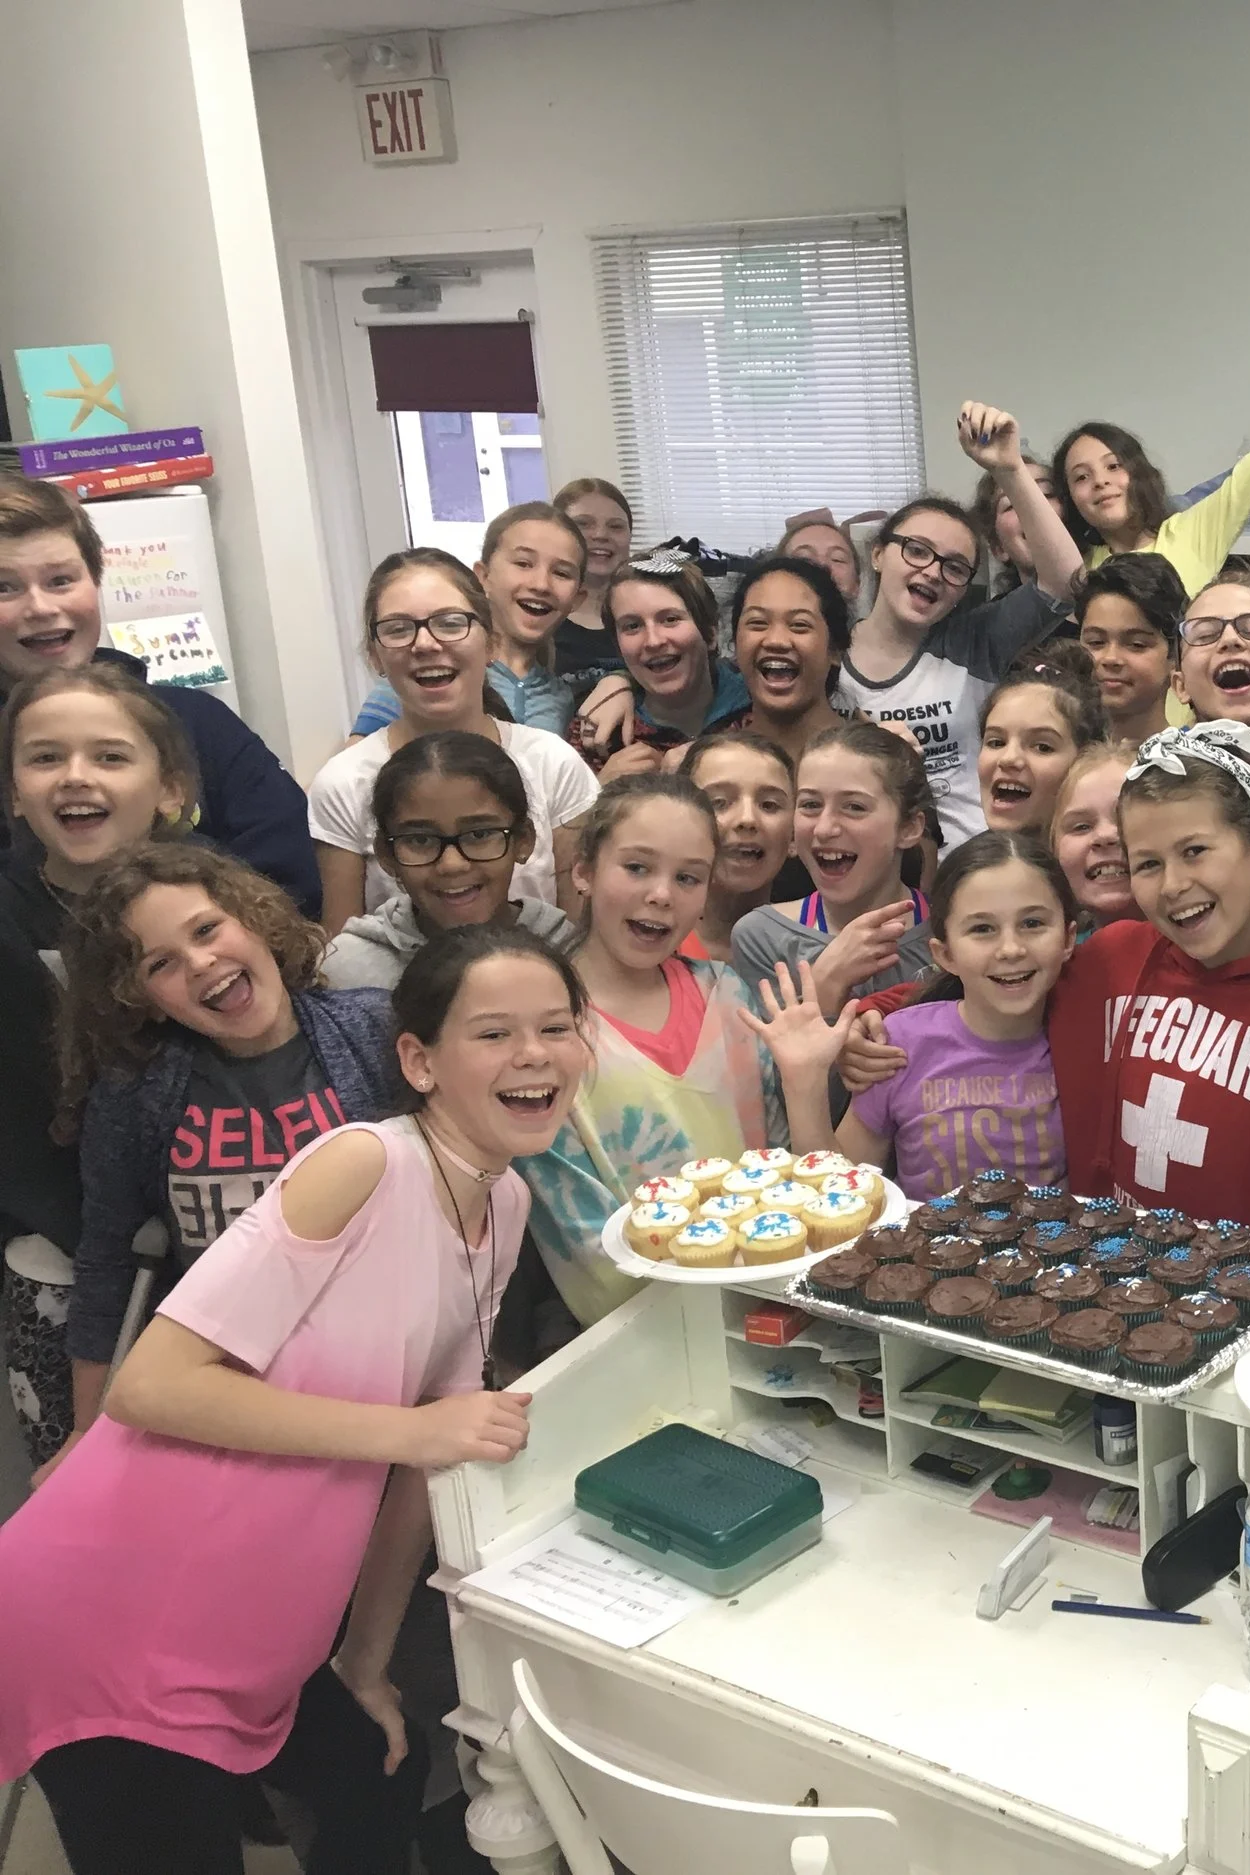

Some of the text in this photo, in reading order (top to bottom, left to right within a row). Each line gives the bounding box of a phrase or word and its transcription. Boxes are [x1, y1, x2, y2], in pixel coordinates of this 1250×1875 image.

[366, 88, 426, 154] EXIT
[52, 450, 69, 461] The
[69, 445, 119, 460] Wonderful
[120, 440, 152, 453] Wizard
[153, 440, 163, 451] of
[163, 439, 177, 449] Oz
[102, 478, 121, 490] YOUR
[121, 473, 149, 488] FAVORITE
[148, 470, 168, 483] SEUSS
[140, 542, 166, 556] you
[115, 586, 142, 603] the
[169, 648, 214, 662] camp
[880, 700, 953, 722] DOESN'T
[912, 722, 949, 745] OU
[922, 1075, 1005, 1112] BECAUSE
